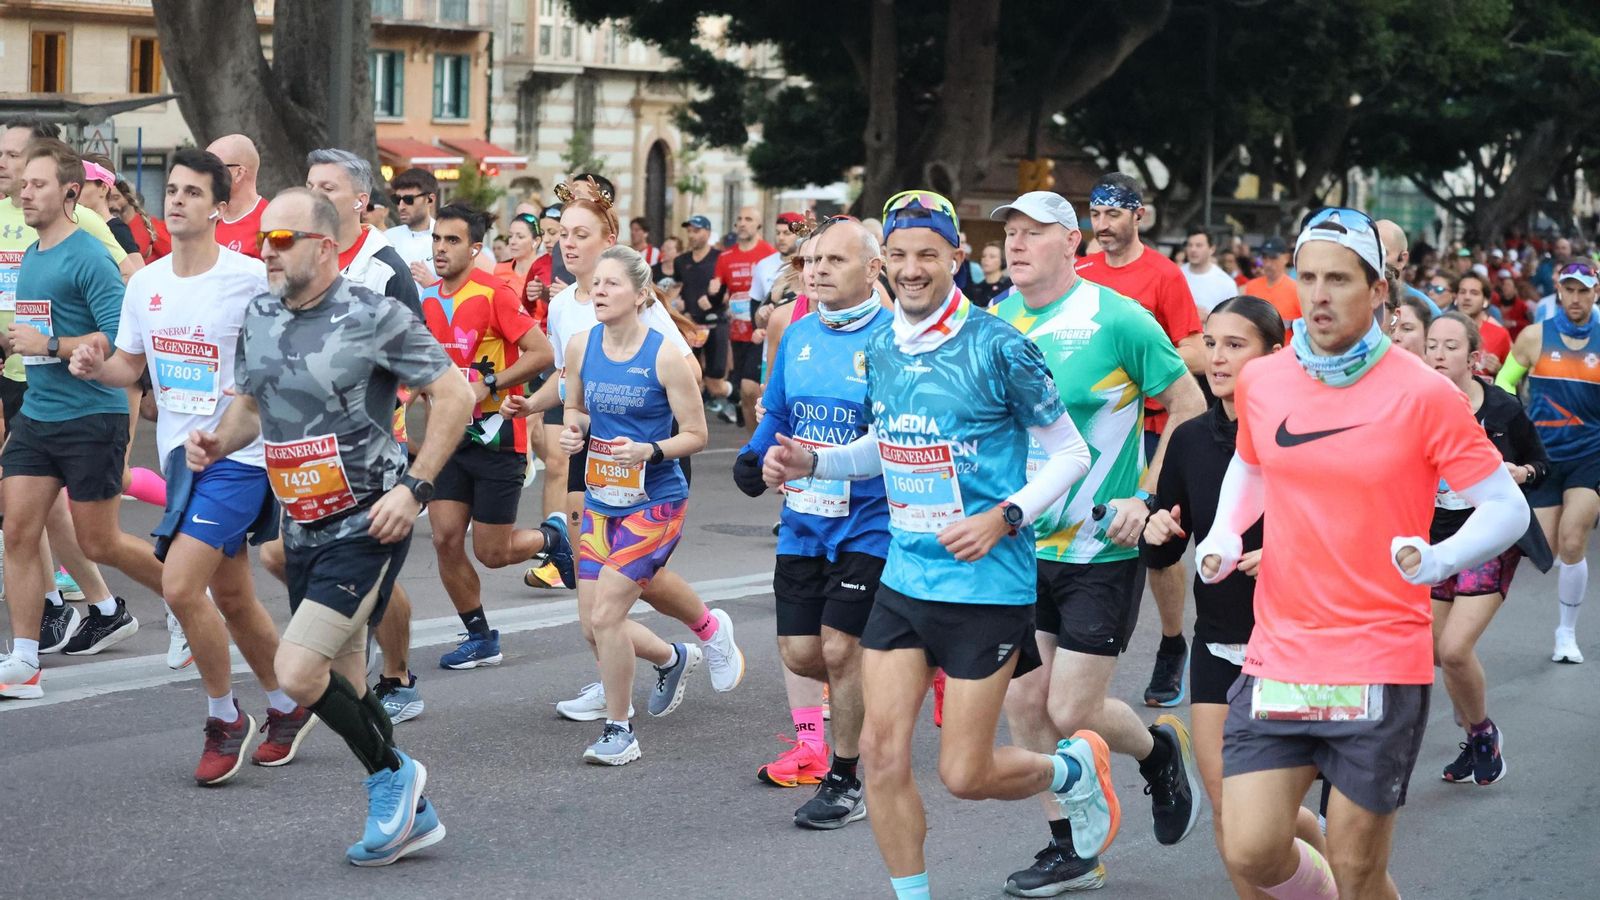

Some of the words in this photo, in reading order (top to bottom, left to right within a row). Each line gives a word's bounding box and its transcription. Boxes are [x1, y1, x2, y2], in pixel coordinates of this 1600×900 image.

[22, 304, 46, 314] GENERALI
[165, 341, 213, 356] GENERALI
[160, 363, 202, 381] 17803
[597, 382, 650, 396] BENTLEY
[592, 392, 645, 407] RUNNING
[596, 403, 627, 415] CLUB
[794, 401, 828, 421] ORO
[833, 406, 857, 424] DE
[888, 413, 940, 436] MEDIA
[274, 440, 330, 459] GENERALI
[890, 447, 945, 464] GENERALI
[595, 462, 630, 479] 14380
[955, 462, 979, 474] 024
[280, 469, 321, 488] 7420
[891, 475, 935, 494] 16007
